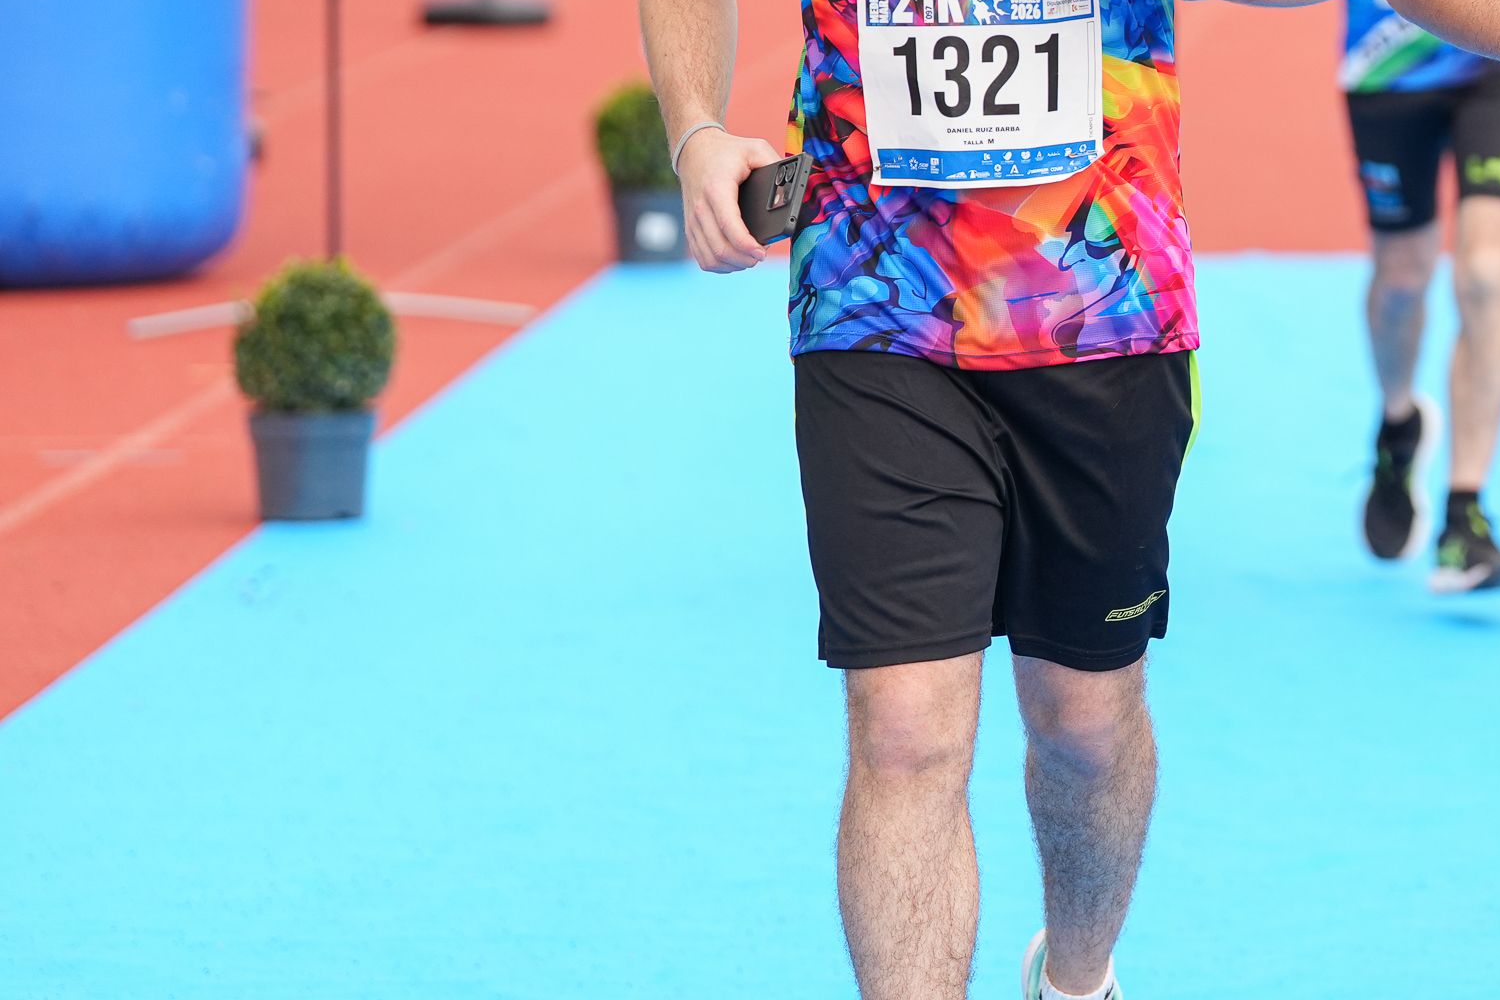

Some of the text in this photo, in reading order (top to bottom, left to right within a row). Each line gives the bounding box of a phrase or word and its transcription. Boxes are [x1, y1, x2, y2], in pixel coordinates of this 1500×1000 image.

[925, 6, 933, 20] 097
[1010, 4, 1041, 20] 2026
[893, 33, 1059, 118] 1321
